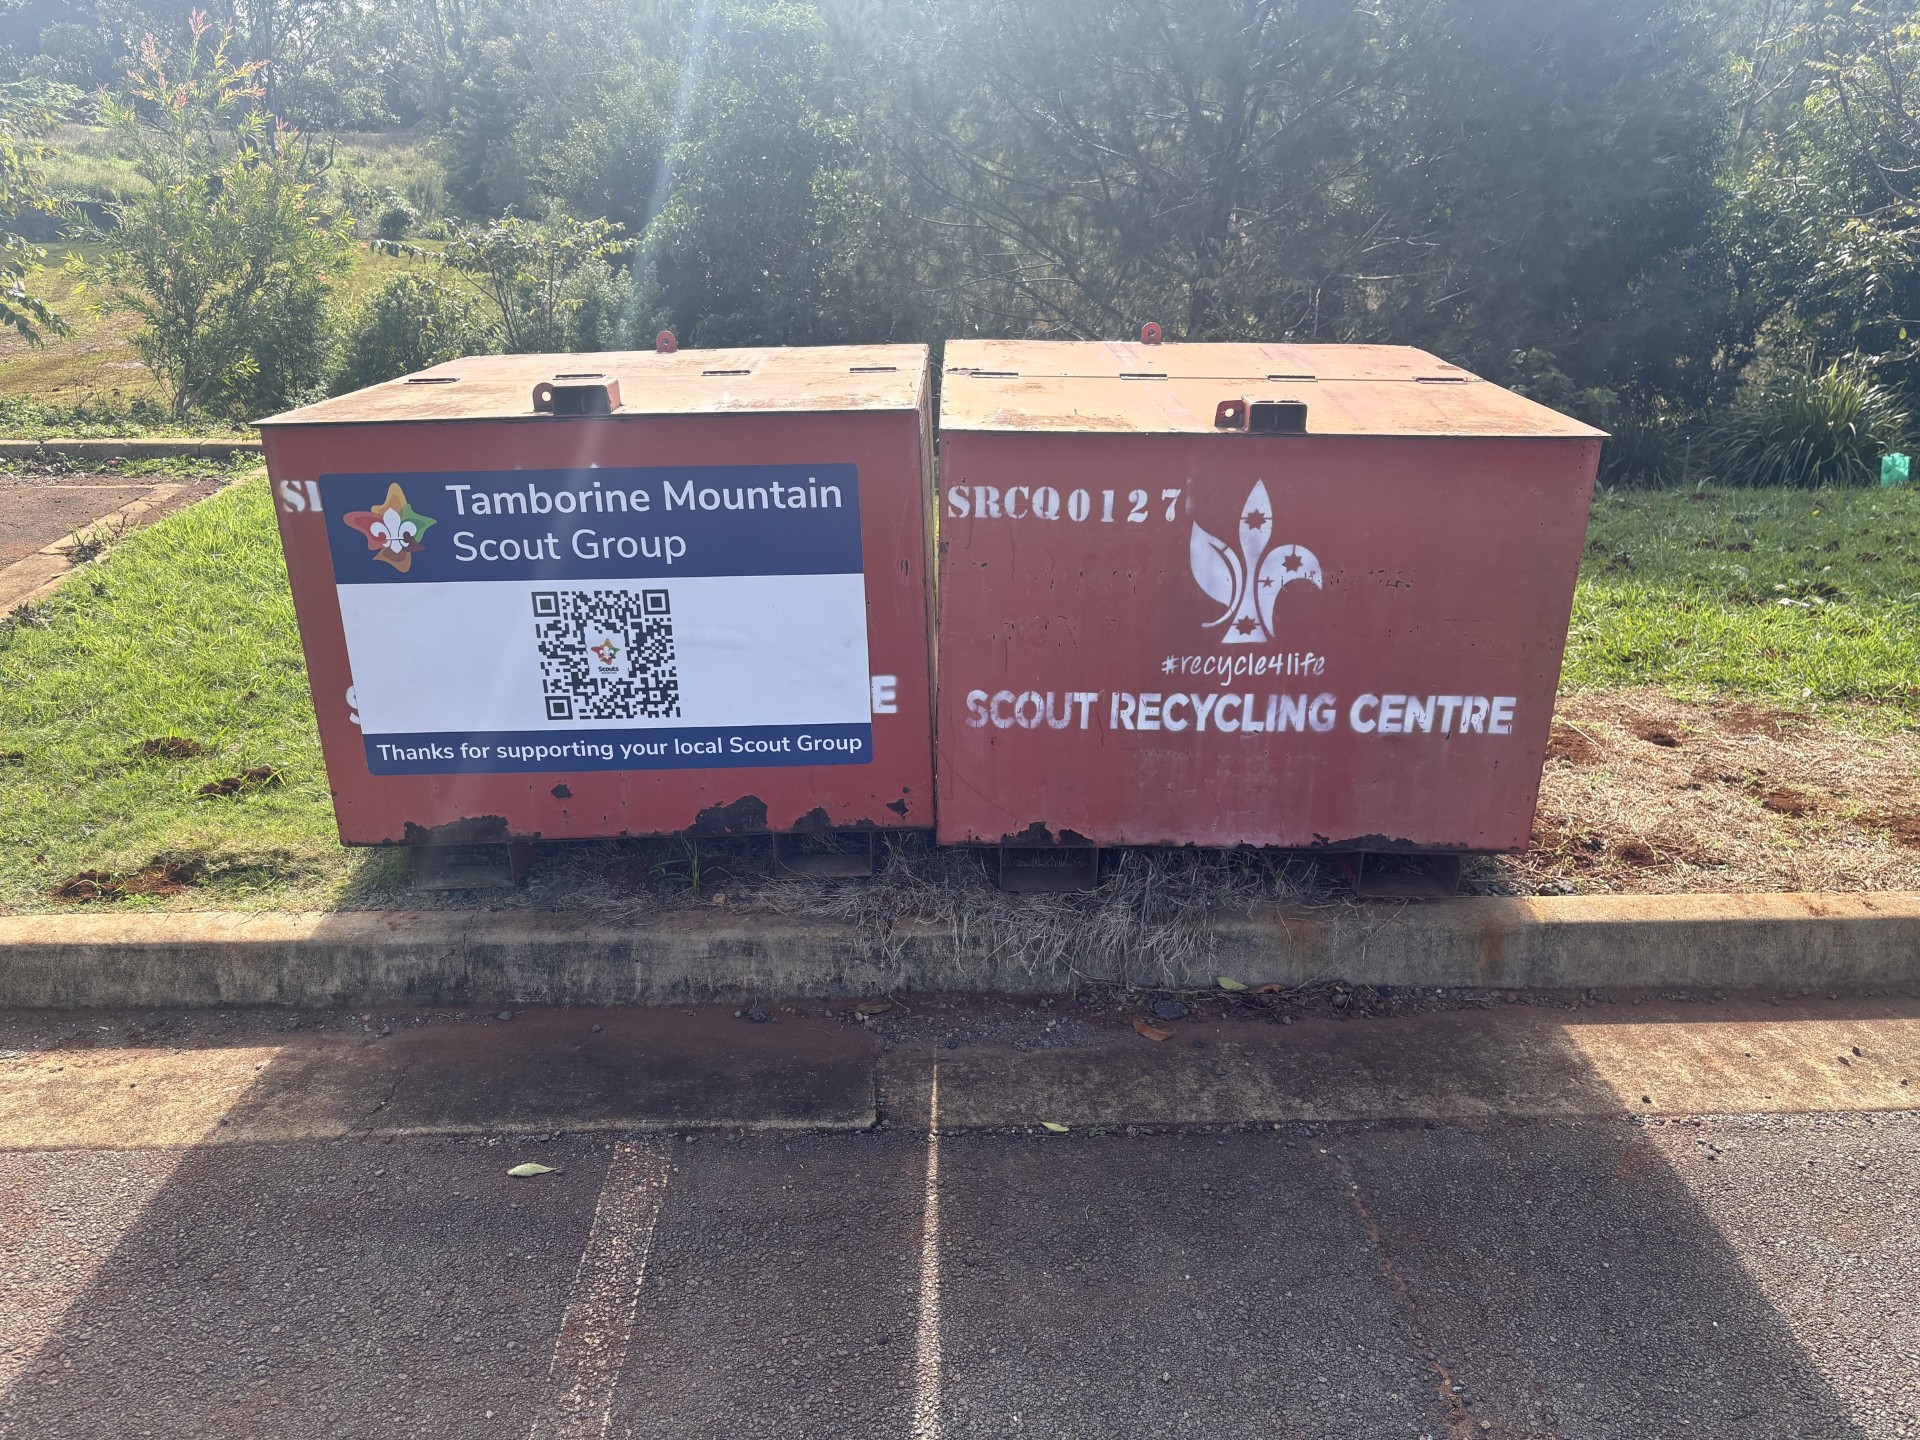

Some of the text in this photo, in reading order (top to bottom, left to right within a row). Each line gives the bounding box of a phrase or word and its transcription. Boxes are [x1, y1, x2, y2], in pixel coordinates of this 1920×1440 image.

[445, 477, 842, 515] Tamborine Mountain
[452, 528, 687, 564] Scout Group
[1161, 652, 1325, 686] #recycle4life
[965, 689, 1517, 734] SCOUT RECYCLING CENTRE
[376, 734, 863, 762] Thanks for supporting your local Scout Group
